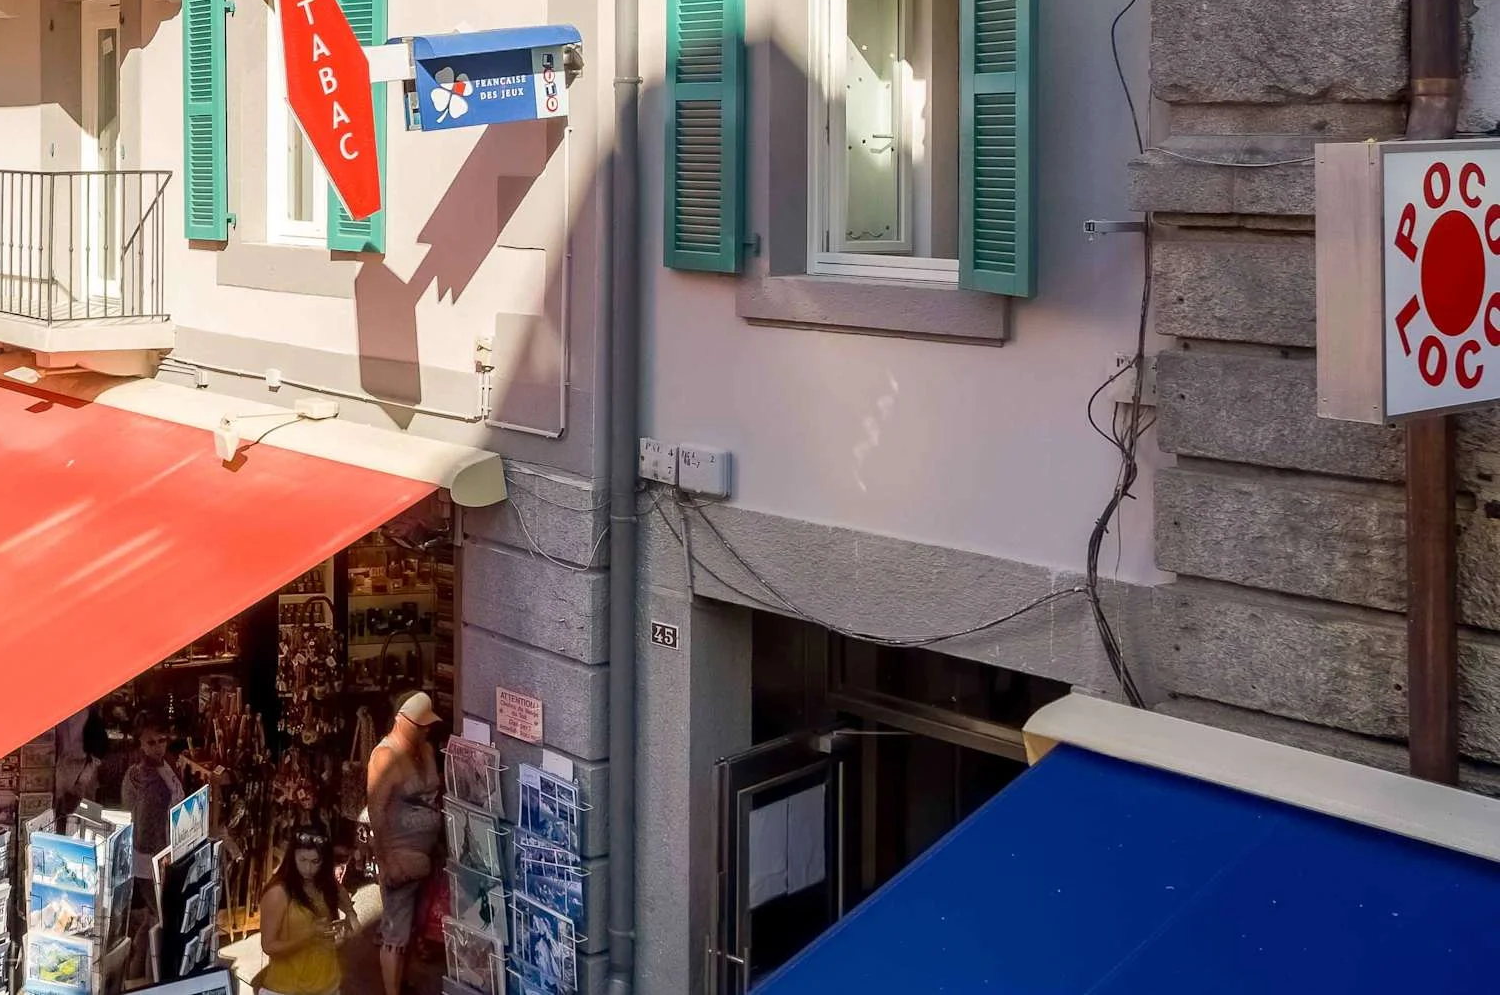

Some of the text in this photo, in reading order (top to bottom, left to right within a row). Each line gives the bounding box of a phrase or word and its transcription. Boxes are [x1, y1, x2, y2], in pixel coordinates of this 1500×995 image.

[480, 87, 524, 100] DES JEUX
[653, 625, 674, 645] 45
